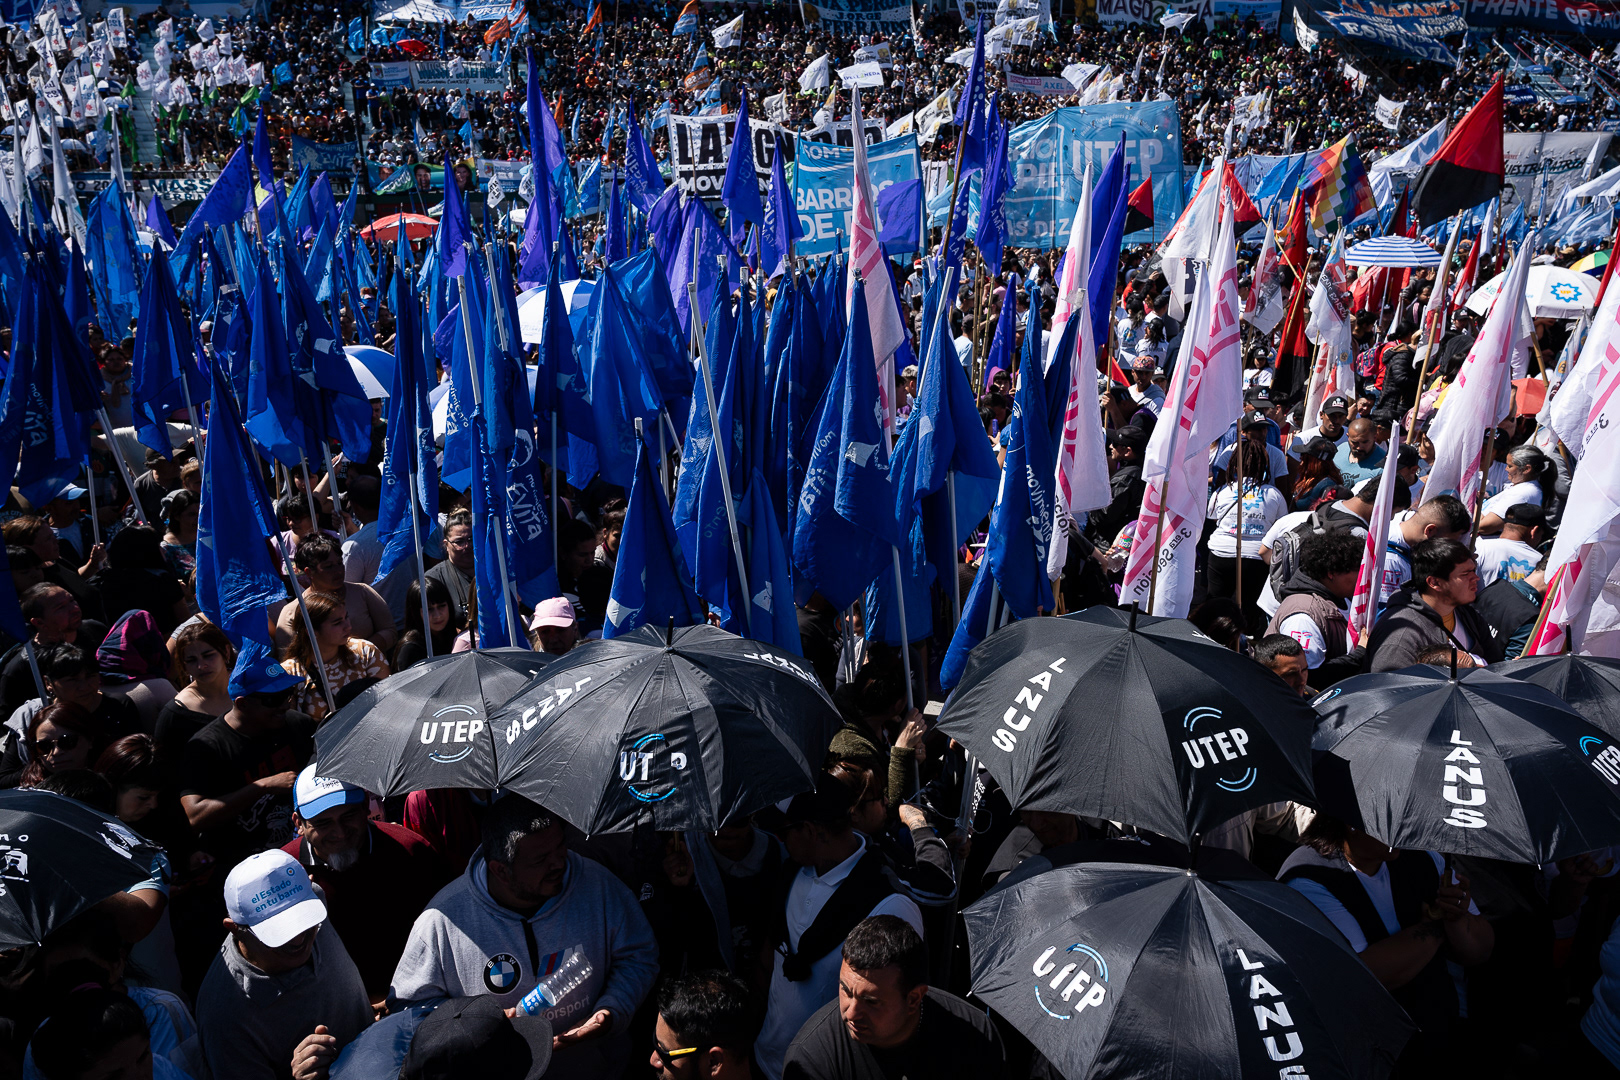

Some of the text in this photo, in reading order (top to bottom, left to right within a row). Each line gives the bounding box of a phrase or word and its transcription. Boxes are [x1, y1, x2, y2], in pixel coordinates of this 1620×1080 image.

[836, 12, 882, 20] JORGE
[1470, 0, 1558, 20] FRENTE
[1043, 82, 1064, 90] AXEL
[796, 179, 894, 212] BARROS
[992, 656, 1067, 753] LANUS
[420, 719, 483, 745] UTEP
[1182, 727, 1250, 769] UTEP
[1442, 729, 1488, 829] LANUS
[251, 879, 292, 904] el Estado
[255, 883, 304, 913] en tu barrio
